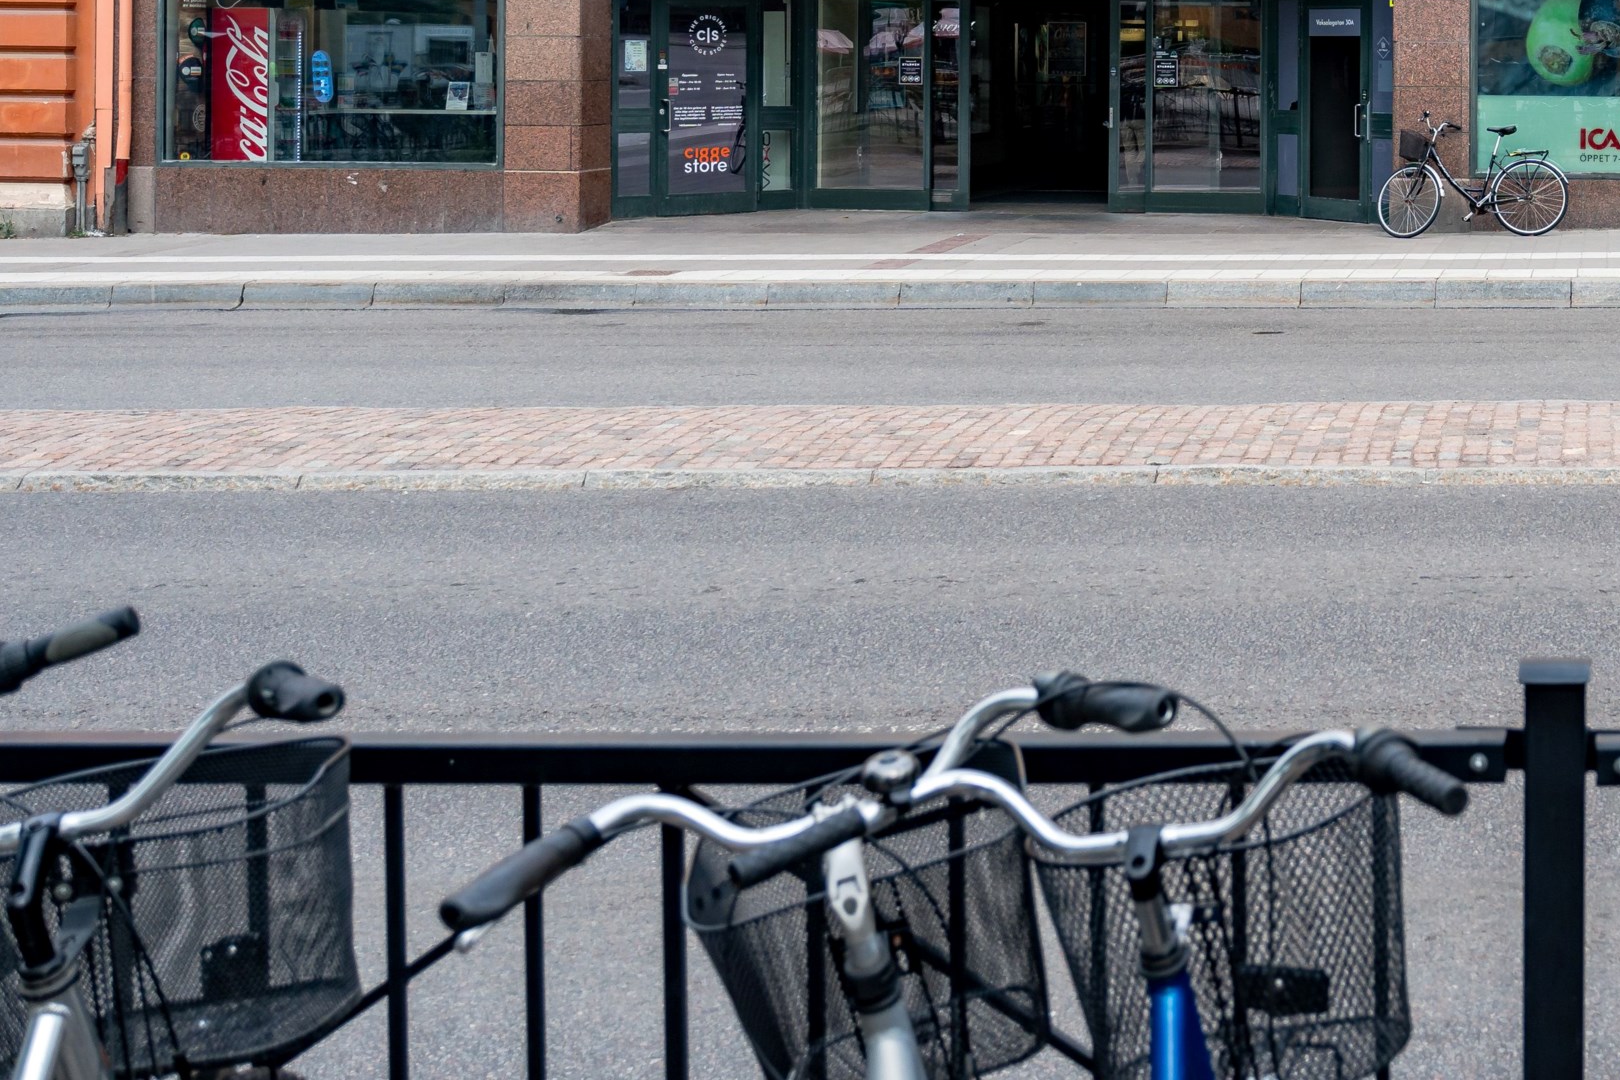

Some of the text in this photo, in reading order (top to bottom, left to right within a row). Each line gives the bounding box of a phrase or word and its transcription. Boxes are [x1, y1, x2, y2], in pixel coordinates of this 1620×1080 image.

[689, 15, 727, 33] THE ORIGINAL
[690, 39, 727, 55] CIGGE STORE
[684, 147, 730, 163] cigge
[1580, 153, 1610, 162] ÖPPET
[684, 159, 727, 173] store
